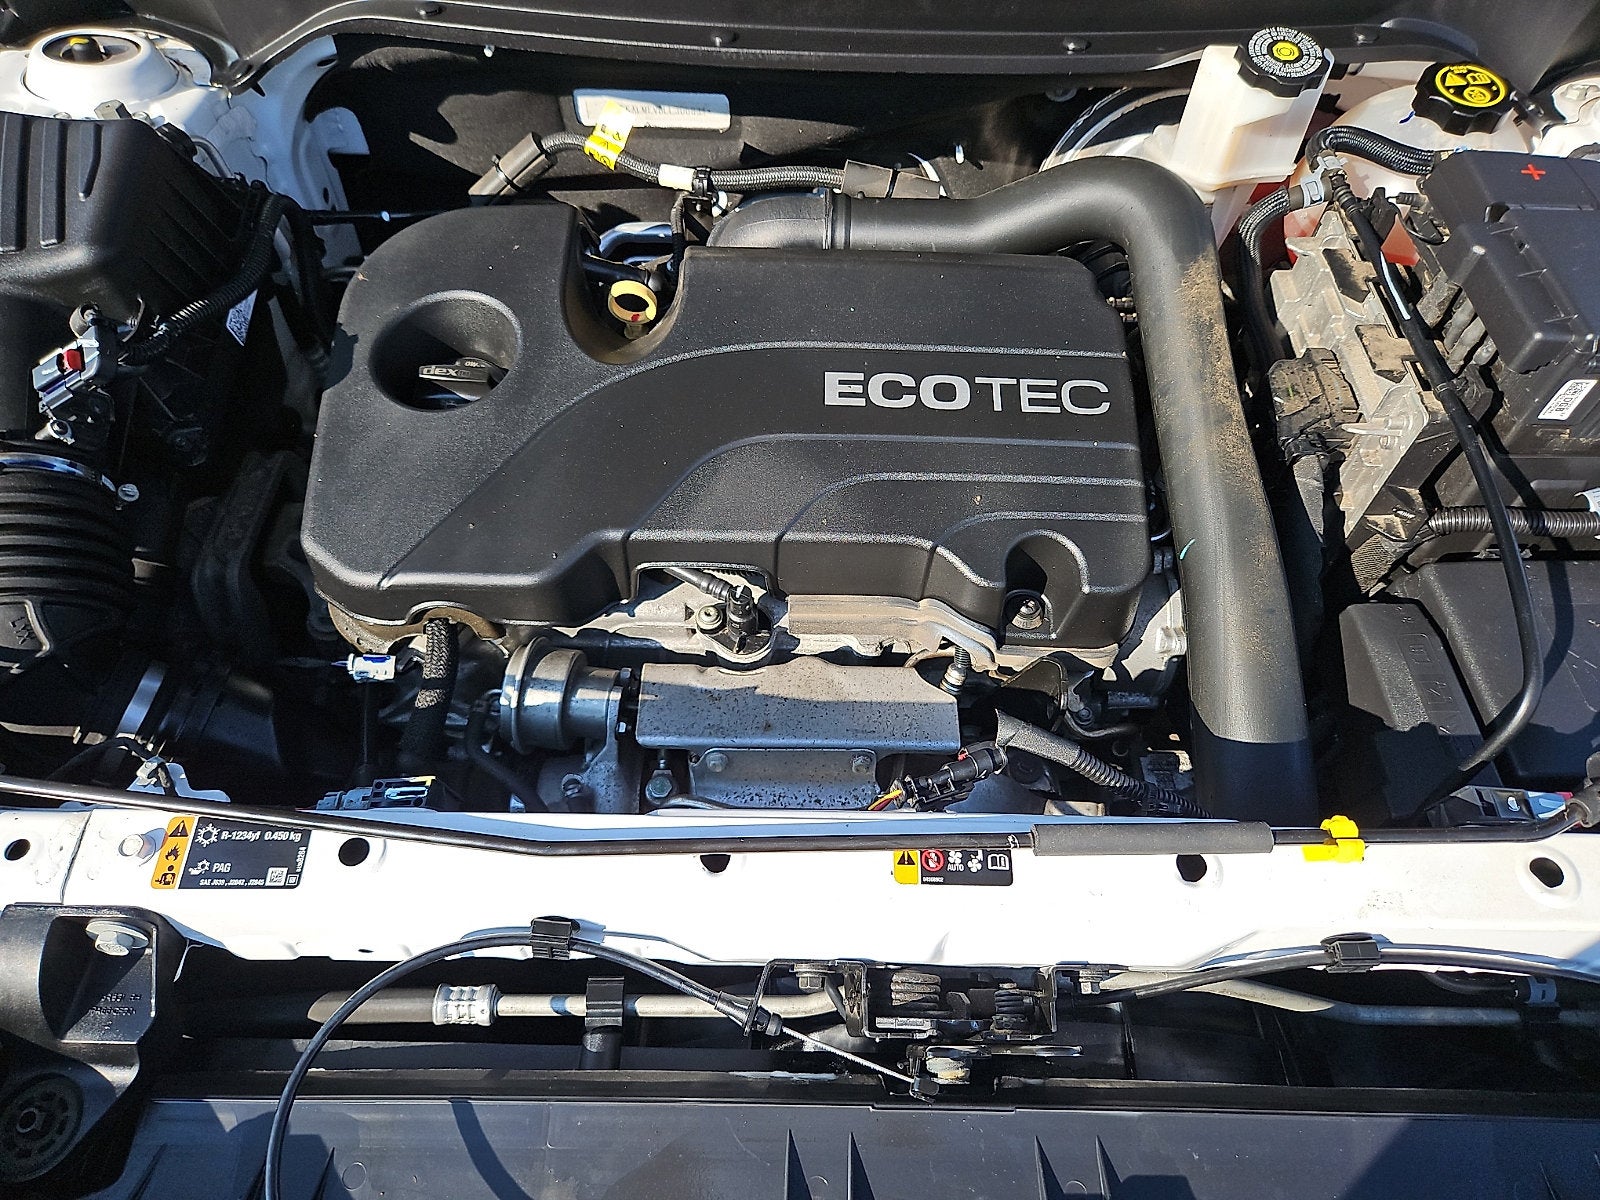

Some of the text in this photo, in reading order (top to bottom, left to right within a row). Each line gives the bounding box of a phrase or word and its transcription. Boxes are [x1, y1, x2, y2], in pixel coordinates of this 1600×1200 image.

[824, 371, 1111, 415] ECOTEC
[221, 831, 302, 843] R-1234yf 0.450 kg
[212, 862, 231, 873] PAG
[947, 864, 964, 872] AUTO
